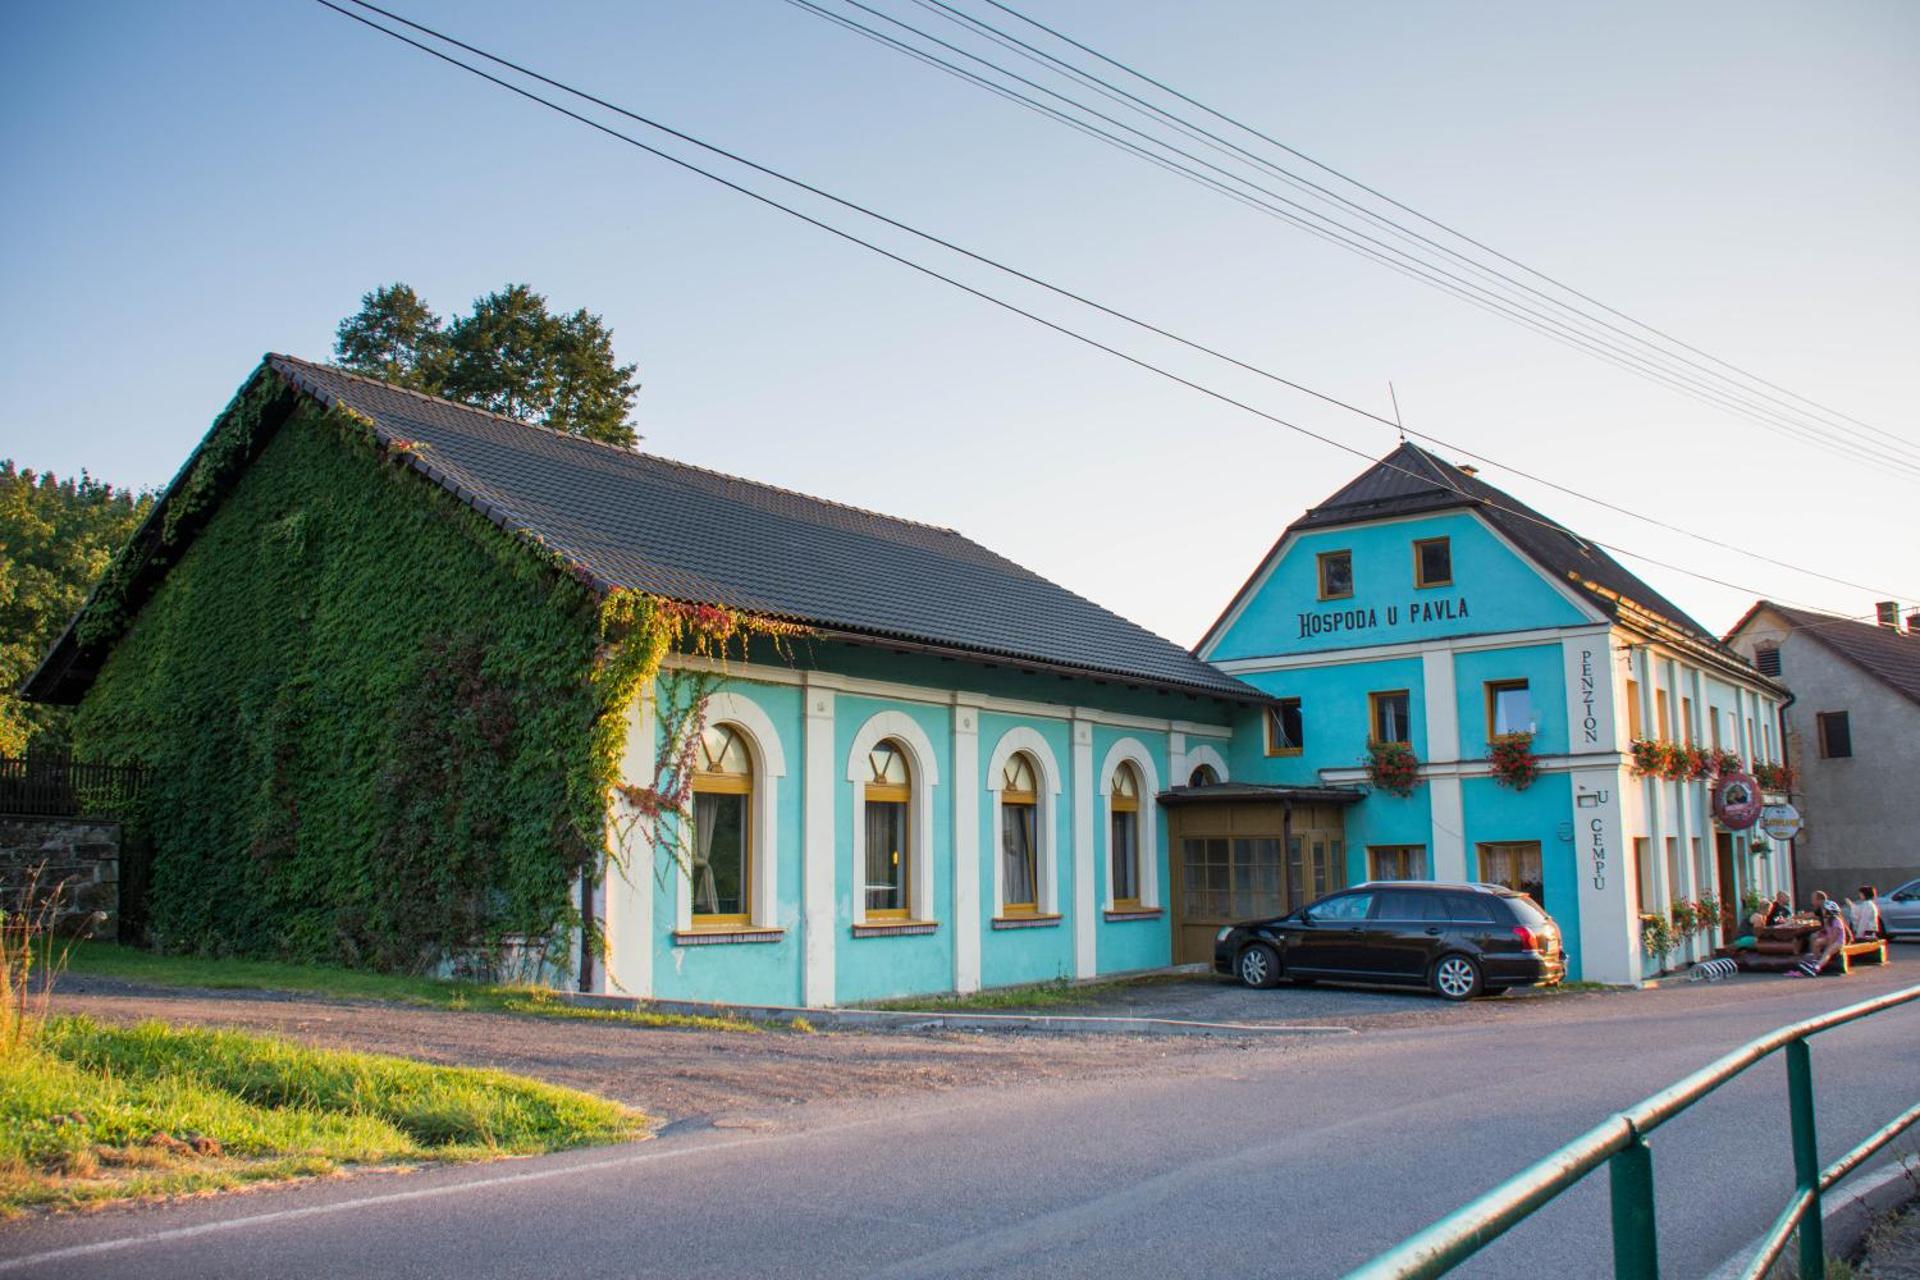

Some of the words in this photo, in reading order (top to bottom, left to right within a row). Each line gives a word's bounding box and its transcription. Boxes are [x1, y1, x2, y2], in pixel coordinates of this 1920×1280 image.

[1297, 608, 1377, 639] HOSPODA
[1387, 606, 1398, 625] U
[1410, 597, 1469, 623] PAVLA
[1581, 650, 1598, 743] PENZION
[1597, 790, 1609, 804] U
